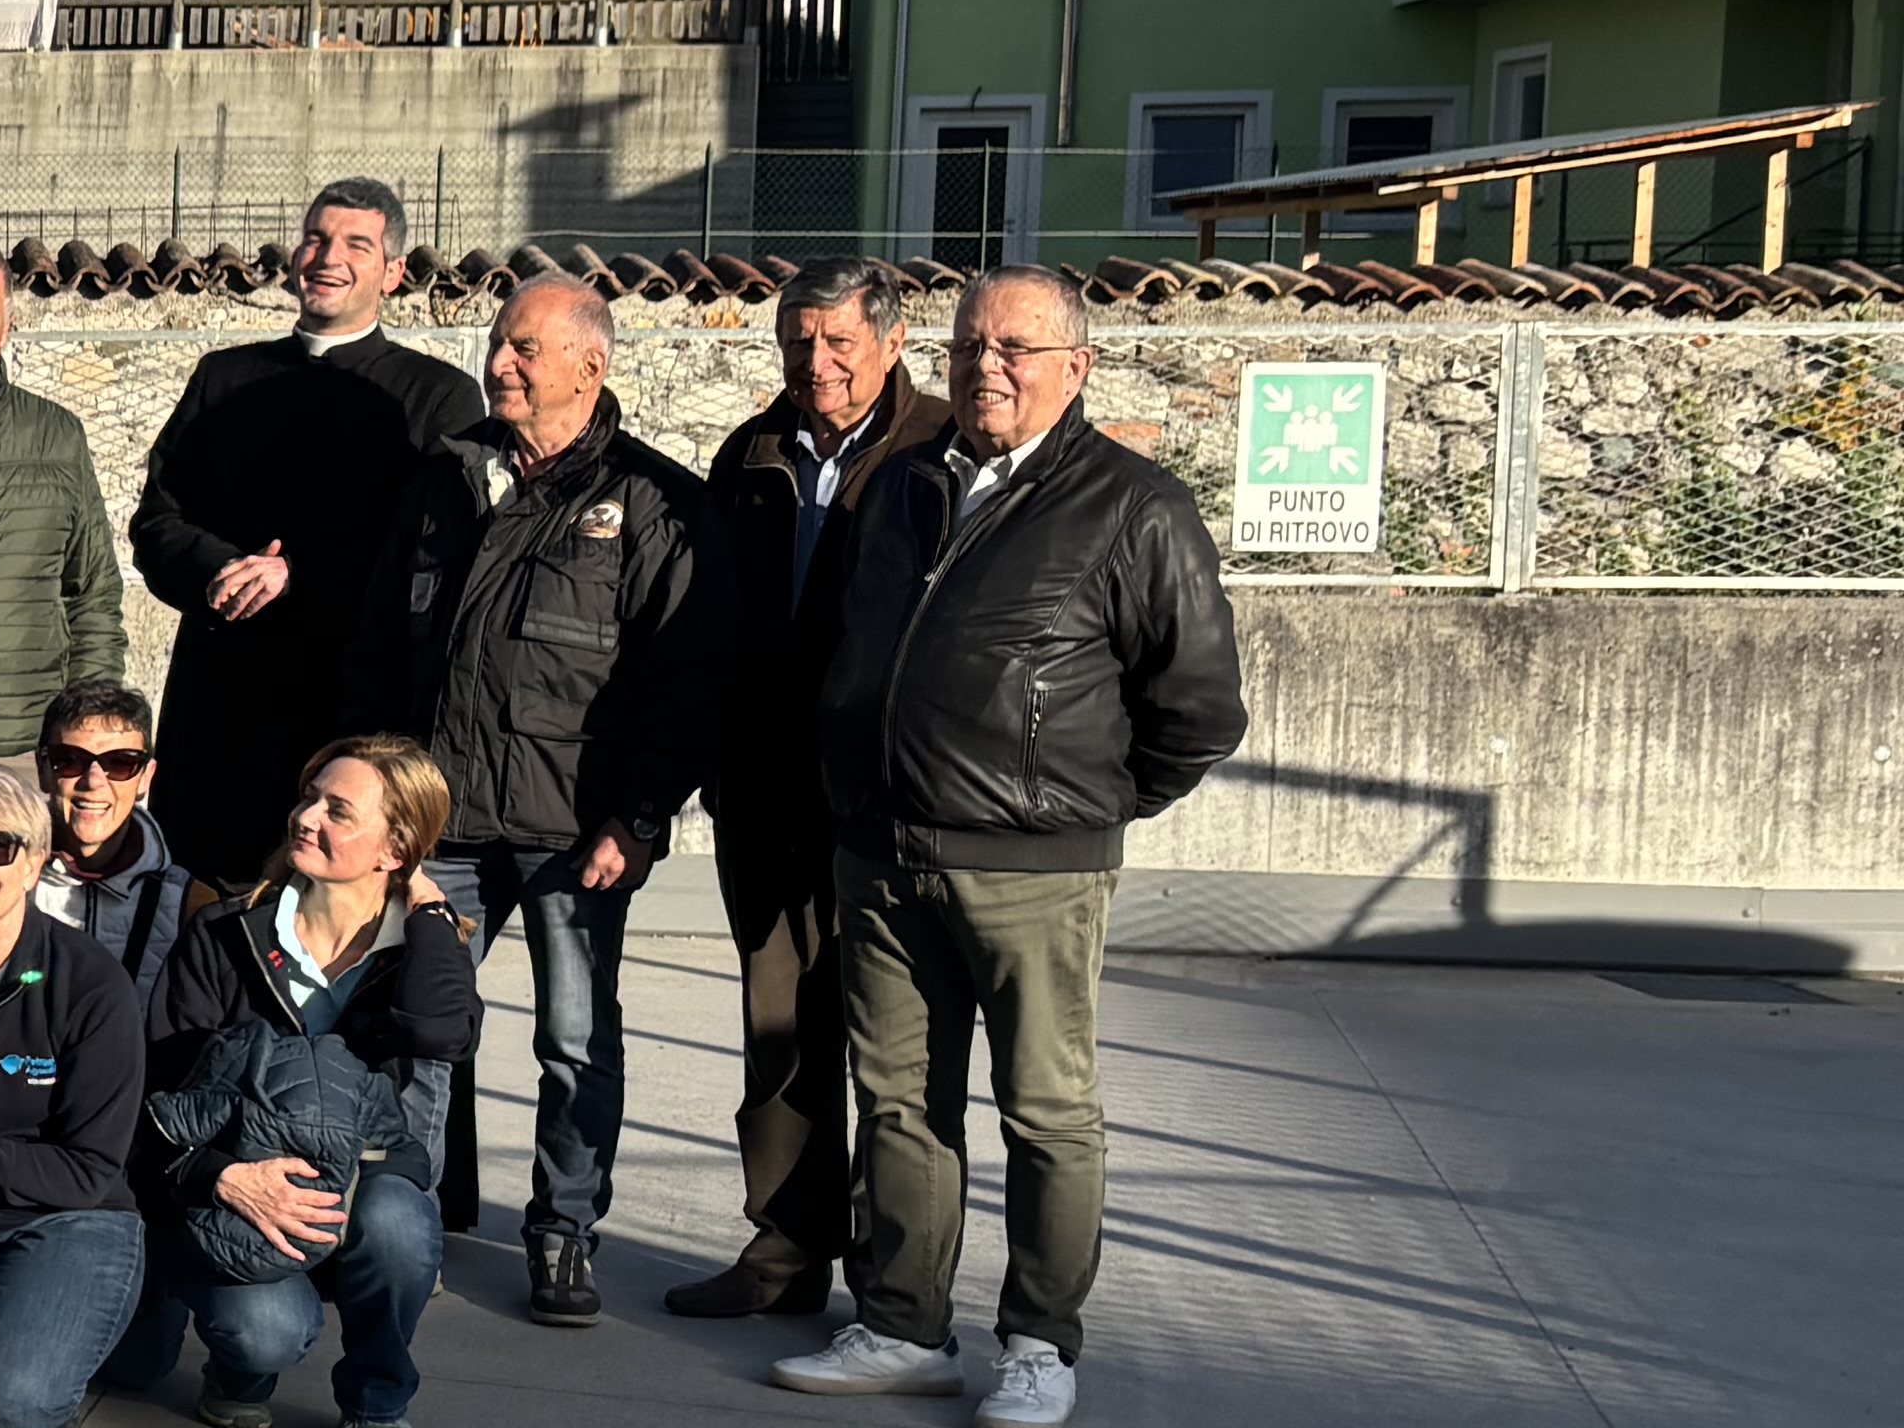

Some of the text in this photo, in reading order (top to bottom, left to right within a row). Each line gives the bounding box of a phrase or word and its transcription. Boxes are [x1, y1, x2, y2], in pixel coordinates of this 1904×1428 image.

[1268, 490, 1345, 512] PUNTO
[1240, 520, 1370, 543] DI RITROVO
